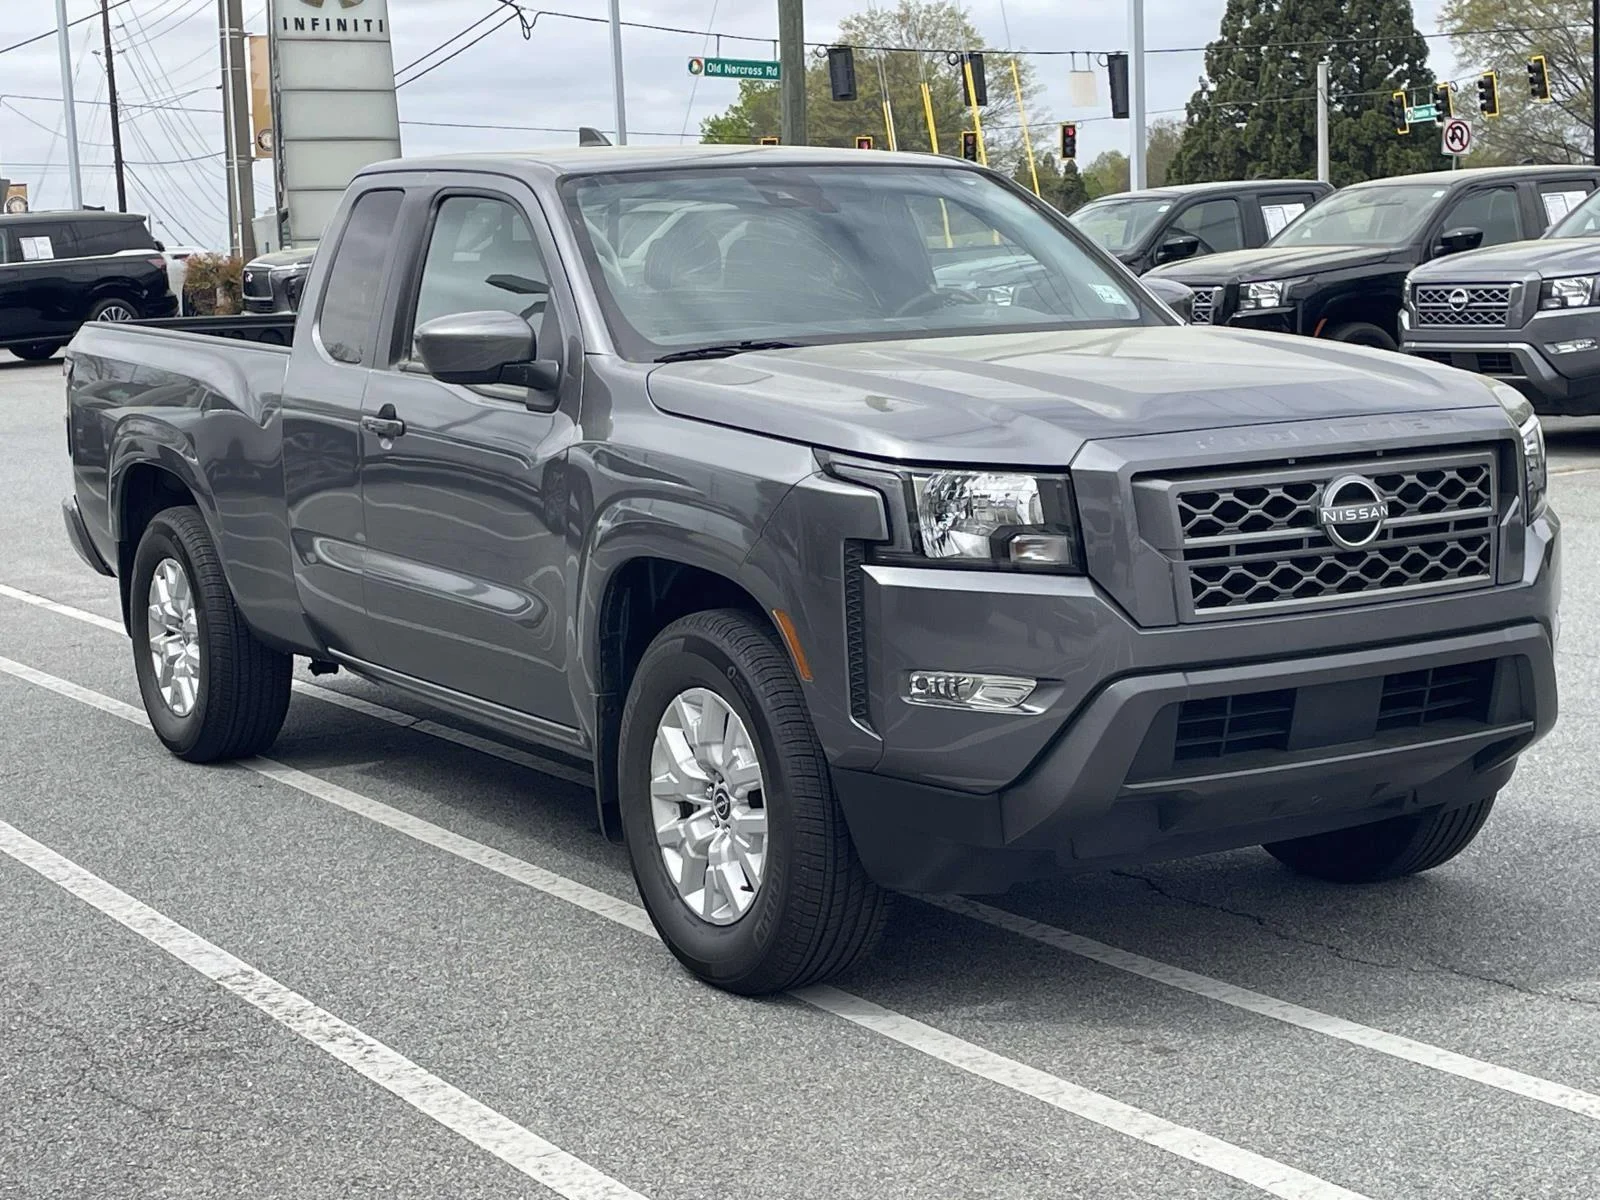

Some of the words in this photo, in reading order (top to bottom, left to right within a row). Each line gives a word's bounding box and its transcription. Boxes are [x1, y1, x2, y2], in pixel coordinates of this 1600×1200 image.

[283, 17, 383, 32] INFINITI
[707, 62, 721, 73] Old
[724, 63, 763, 75] Norcross
[766, 66, 778, 77] Rd
[1322, 505, 1388, 522] NISSAN
